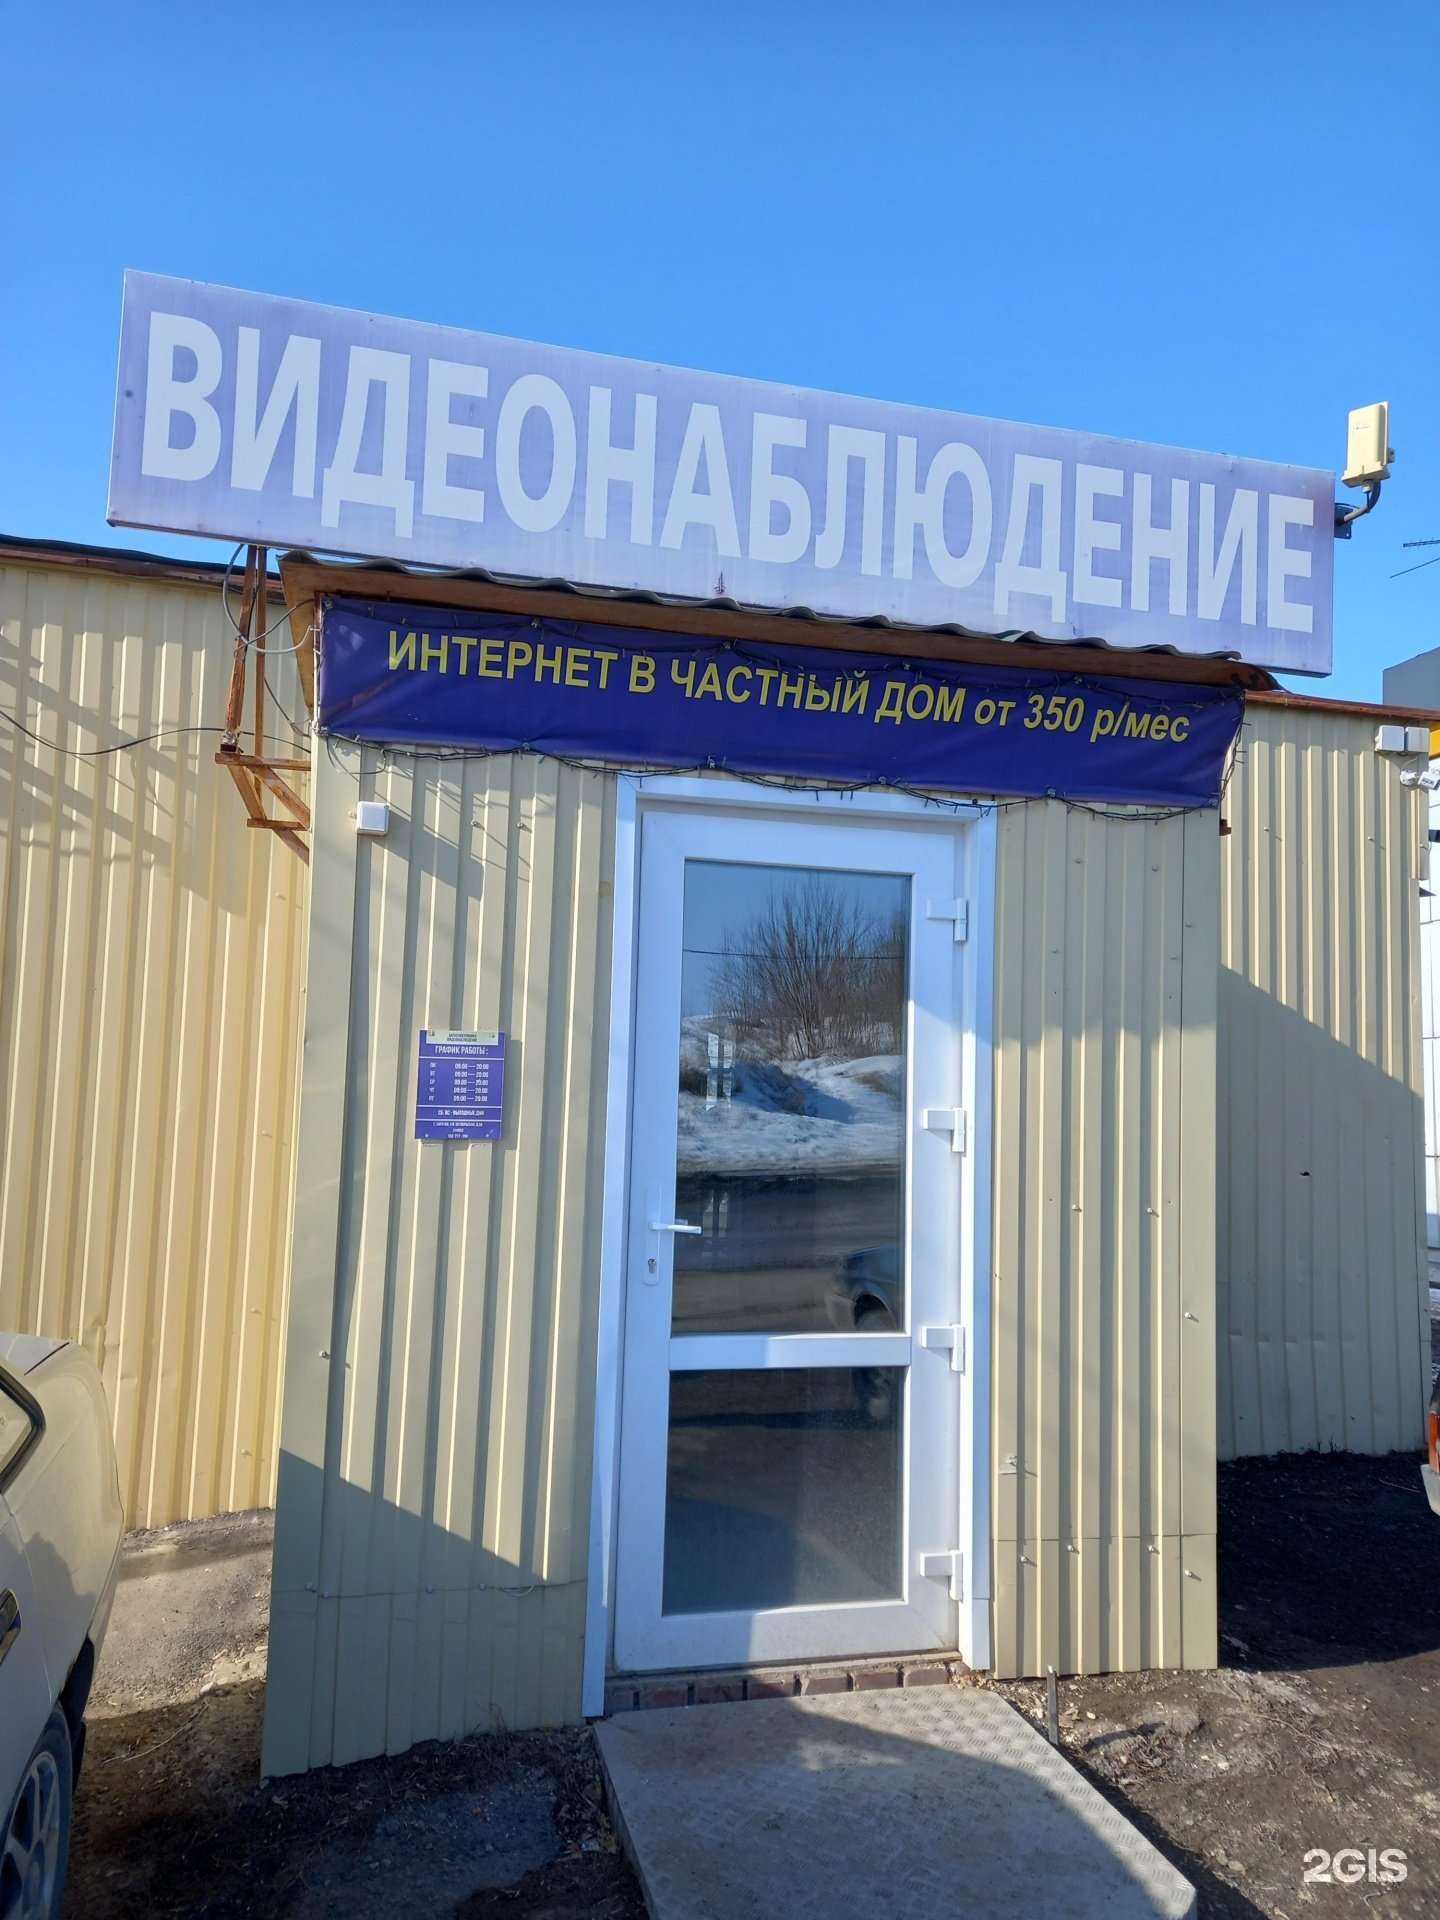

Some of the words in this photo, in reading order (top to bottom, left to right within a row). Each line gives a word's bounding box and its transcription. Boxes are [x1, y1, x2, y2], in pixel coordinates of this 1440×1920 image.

[141, 311, 1315, 633] ВИДЕОНАБЛЮДЕНИЕ
[388, 630, 618, 689] ИНТЕРНЕТ
[628, 656, 656, 693] В
[671, 660, 869, 715] ЧАСТНЫЙ
[874, 681, 966, 725] ДОМ
[974, 698, 1016, 726] от
[1023, 694, 1085, 732] 350
[1090, 704, 1190, 743] р/мес
[435, 1045, 460, 1055] ГРАФИК
